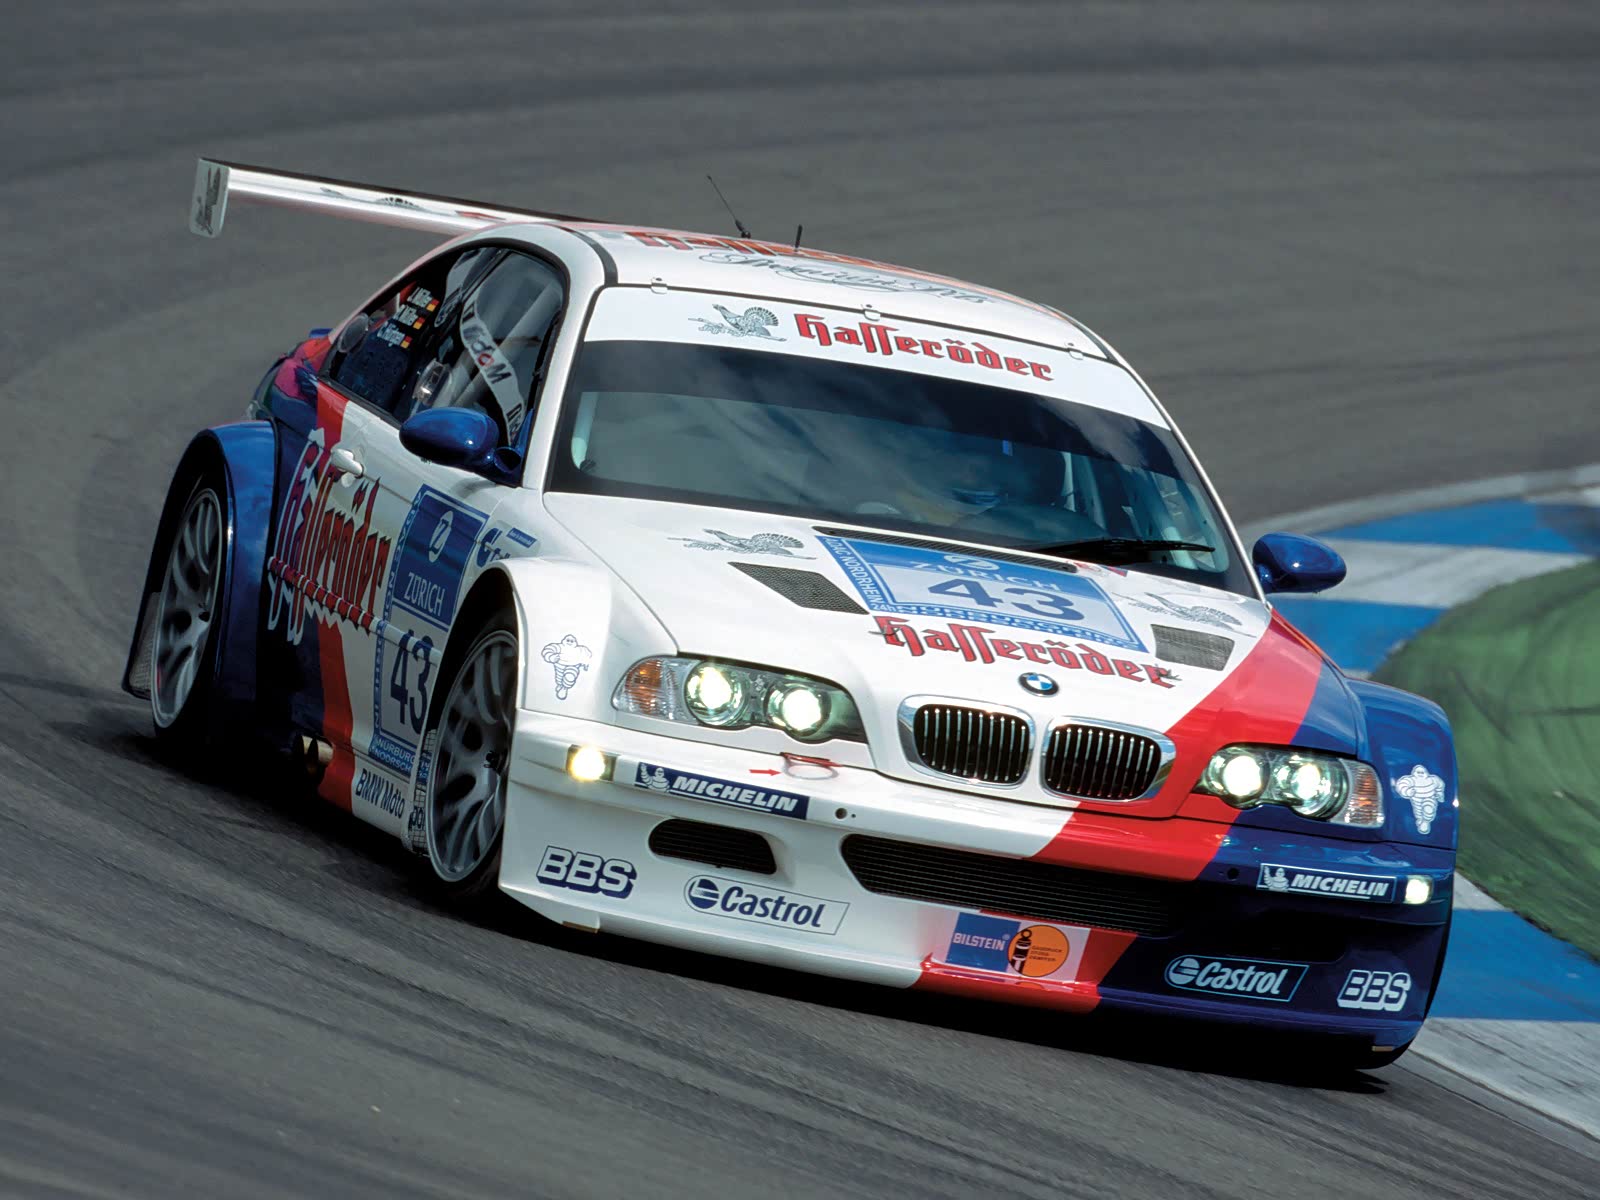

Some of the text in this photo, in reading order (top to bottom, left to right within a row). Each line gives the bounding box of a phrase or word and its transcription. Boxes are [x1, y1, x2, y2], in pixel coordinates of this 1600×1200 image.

[840, 555, 887, 604] NORDRHEIN
[928, 578, 1085, 620] 43
[870, 602, 898, 612] 24h
[390, 628, 434, 735] 43
[355, 767, 385, 806] BMW
[670, 775, 799, 812] MICHELIN
[536, 845, 637, 899] BBS
[1291, 873, 1389, 897] MICHELIN
[720, 886, 825, 928] Castrol
[952, 932, 1006, 951] BILSTEIN
[1196, 961, 1288, 995] Castrol
[1336, 969, 1411, 1012] BBS
